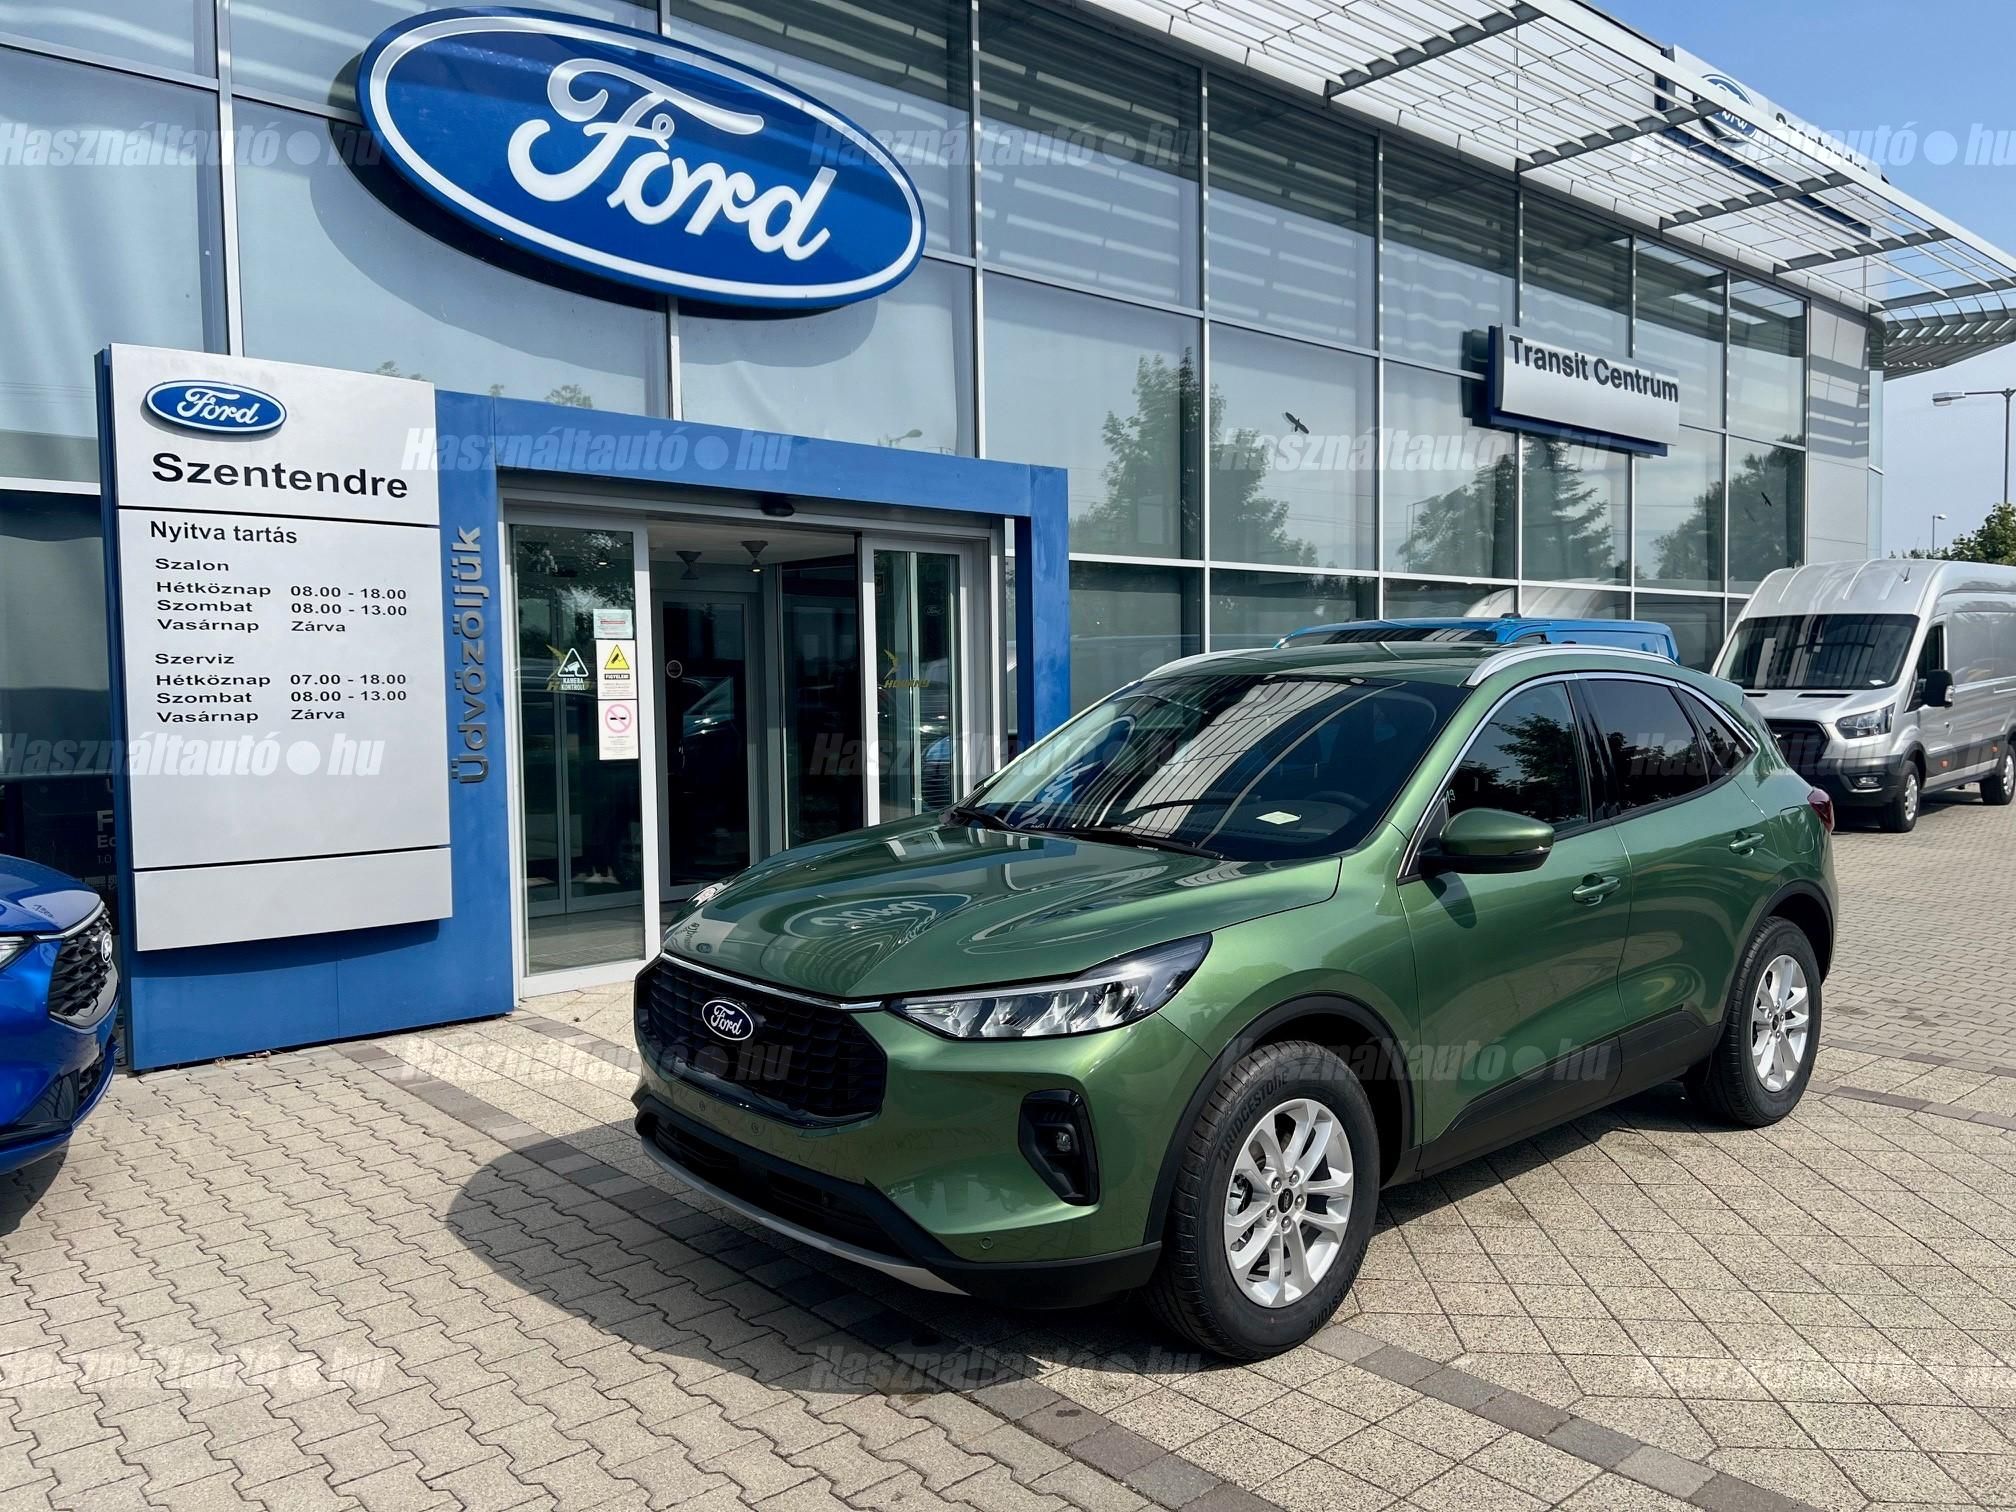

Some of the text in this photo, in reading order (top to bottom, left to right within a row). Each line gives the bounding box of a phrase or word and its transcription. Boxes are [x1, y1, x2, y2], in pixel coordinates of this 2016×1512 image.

[508, 58, 837, 260] Ford
[1509, 335, 1679, 403] Transit Centrum
[176, 387, 261, 424] Ford
[152, 452, 408, 498] Szentendre
[150, 521, 298, 544] Nyitva tartás
[155, 558, 229, 572] Szalon
[156, 581, 272, 598] Hétköznap
[290, 586, 341, 598] 08.00
[360, 588, 407, 600] 18.00
[157, 600, 253, 613] Szombat
[291, 603, 342, 615] 08.00
[361, 605, 408, 616] 13.00
[157, 618, 346, 634] Vasárnap Zárva
[155, 653, 235, 665] Szerviz
[451, 526, 490, 784] Üdvözöljük
[156, 674, 271, 688] Hétköznap
[290, 674, 341, 685] 07.00
[360, 674, 406, 685] 18.00
[156, 691, 252, 704] Szombat
[290, 691, 341, 702] 08.00
[360, 690, 407, 701] 13.00
[157, 709, 345, 724] Vasárnap Zárva
[710, 1005, 742, 1035] Ford
[1217, 1072, 1290, 1166] BRIDGESTONE
